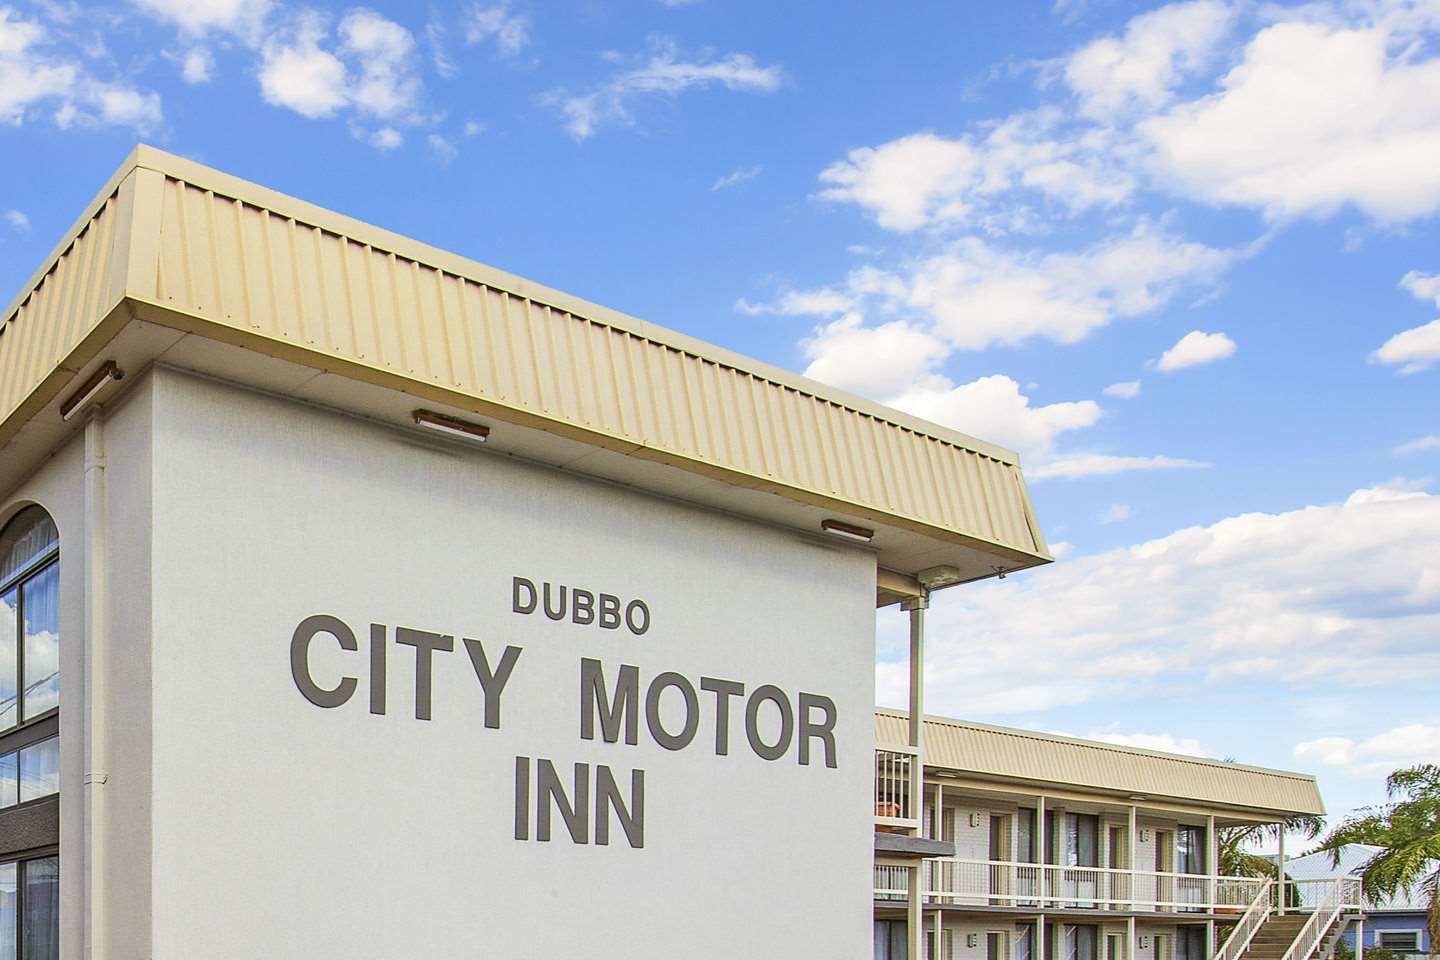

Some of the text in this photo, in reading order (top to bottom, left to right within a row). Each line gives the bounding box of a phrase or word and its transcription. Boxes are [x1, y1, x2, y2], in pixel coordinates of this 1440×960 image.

[512, 576, 650, 635] DUBBO
[290, 614, 838, 769] CITY MOTOR
[514, 756, 645, 849] INN
